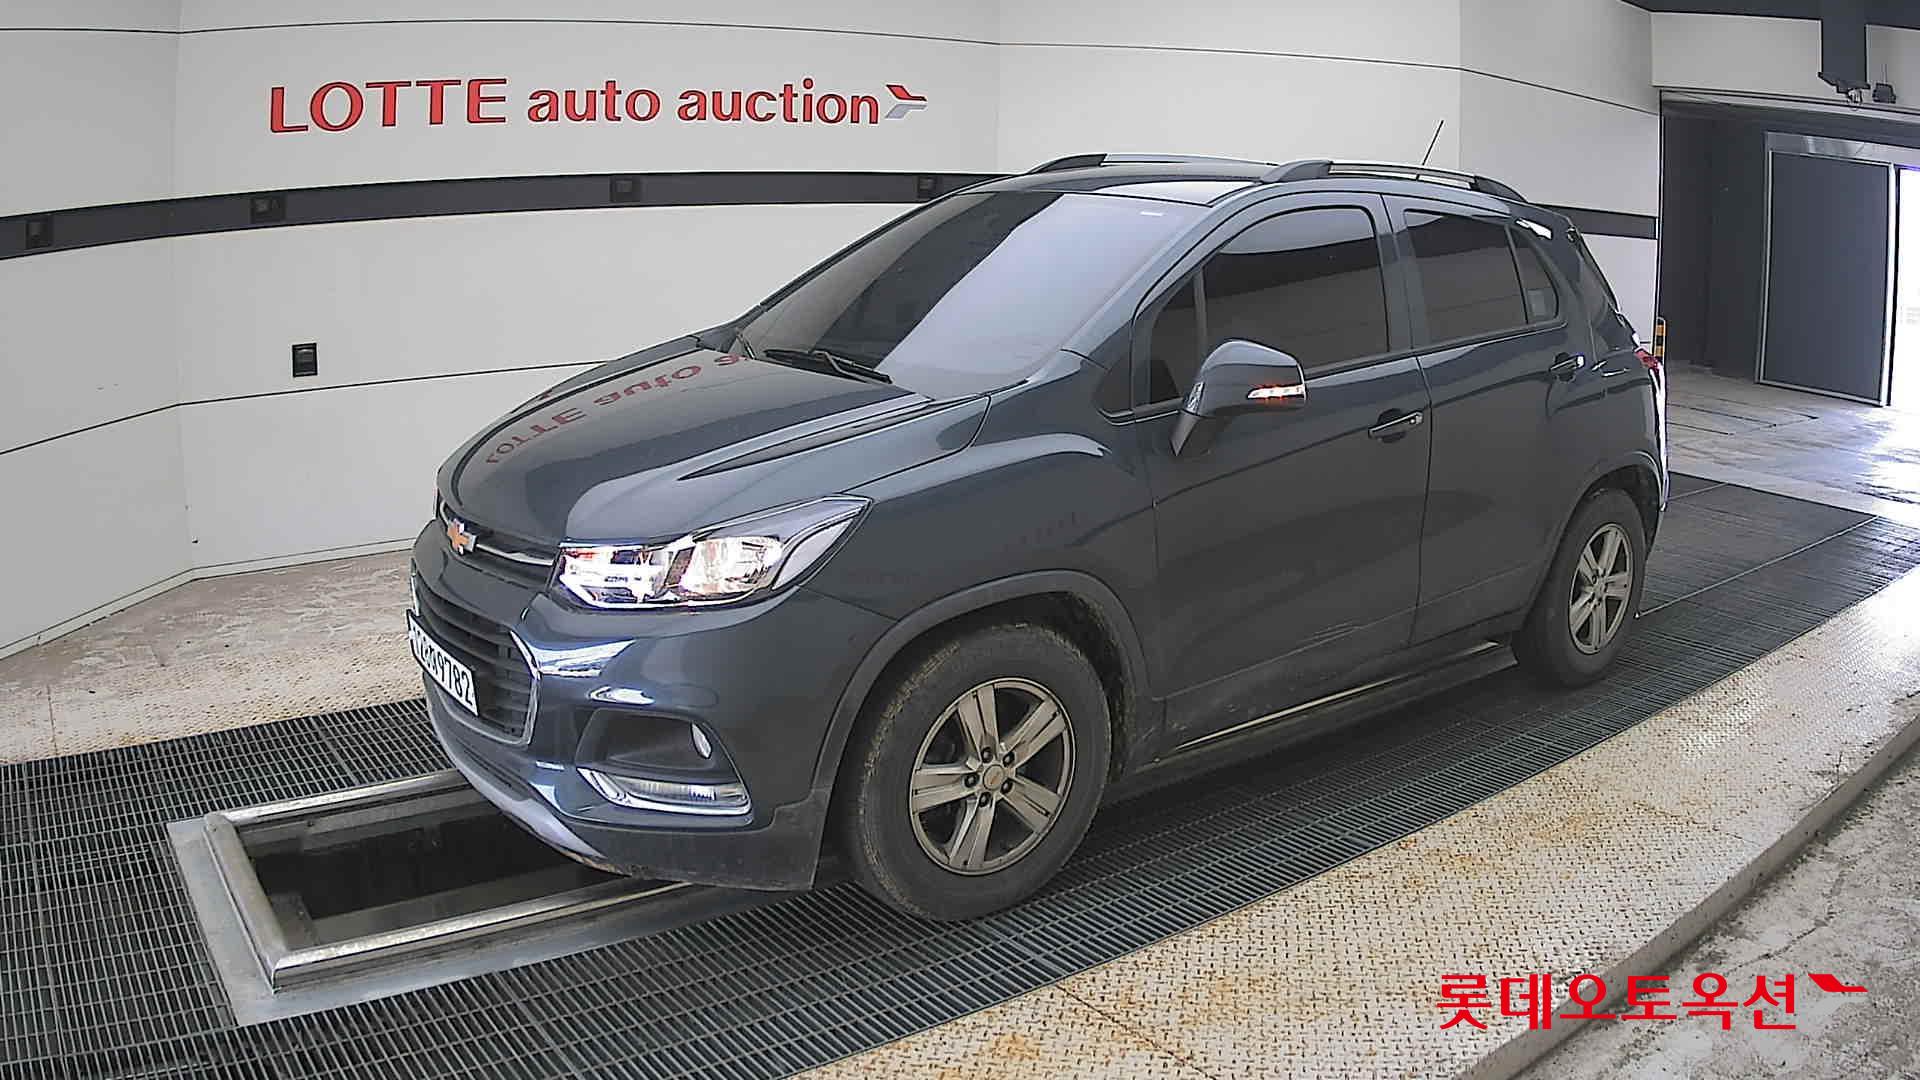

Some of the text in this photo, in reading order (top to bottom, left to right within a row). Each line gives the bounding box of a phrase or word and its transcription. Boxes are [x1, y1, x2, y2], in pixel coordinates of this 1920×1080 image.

[269, 78, 879, 133] LOTTE auto auction
